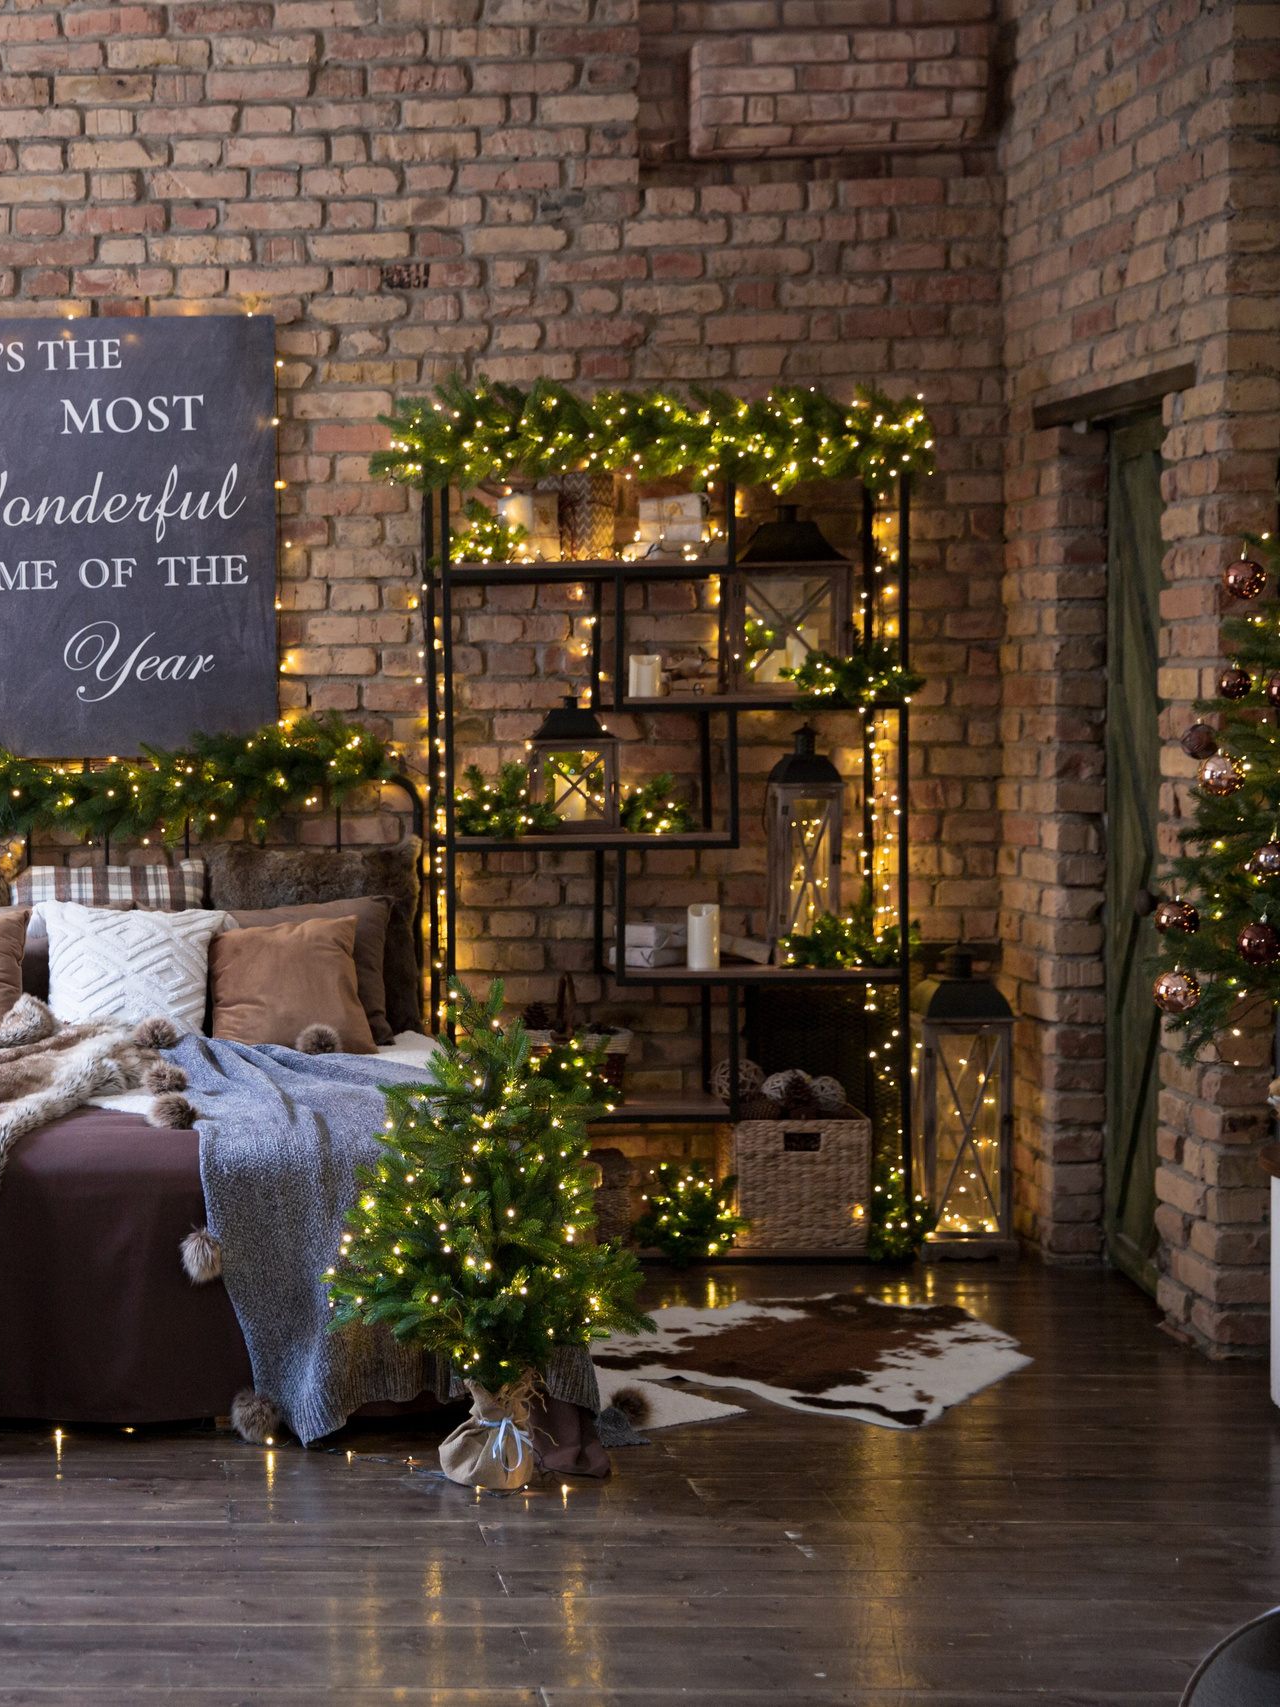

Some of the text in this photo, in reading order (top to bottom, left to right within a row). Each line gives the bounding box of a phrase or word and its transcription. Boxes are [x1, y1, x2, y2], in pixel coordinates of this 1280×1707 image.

[38, 338, 122, 371] THE
[60, 394, 204, 435] MOST
[78, 557, 138, 589] OF
[157, 554, 249, 587] THE
[63, 620, 216, 703] Year
